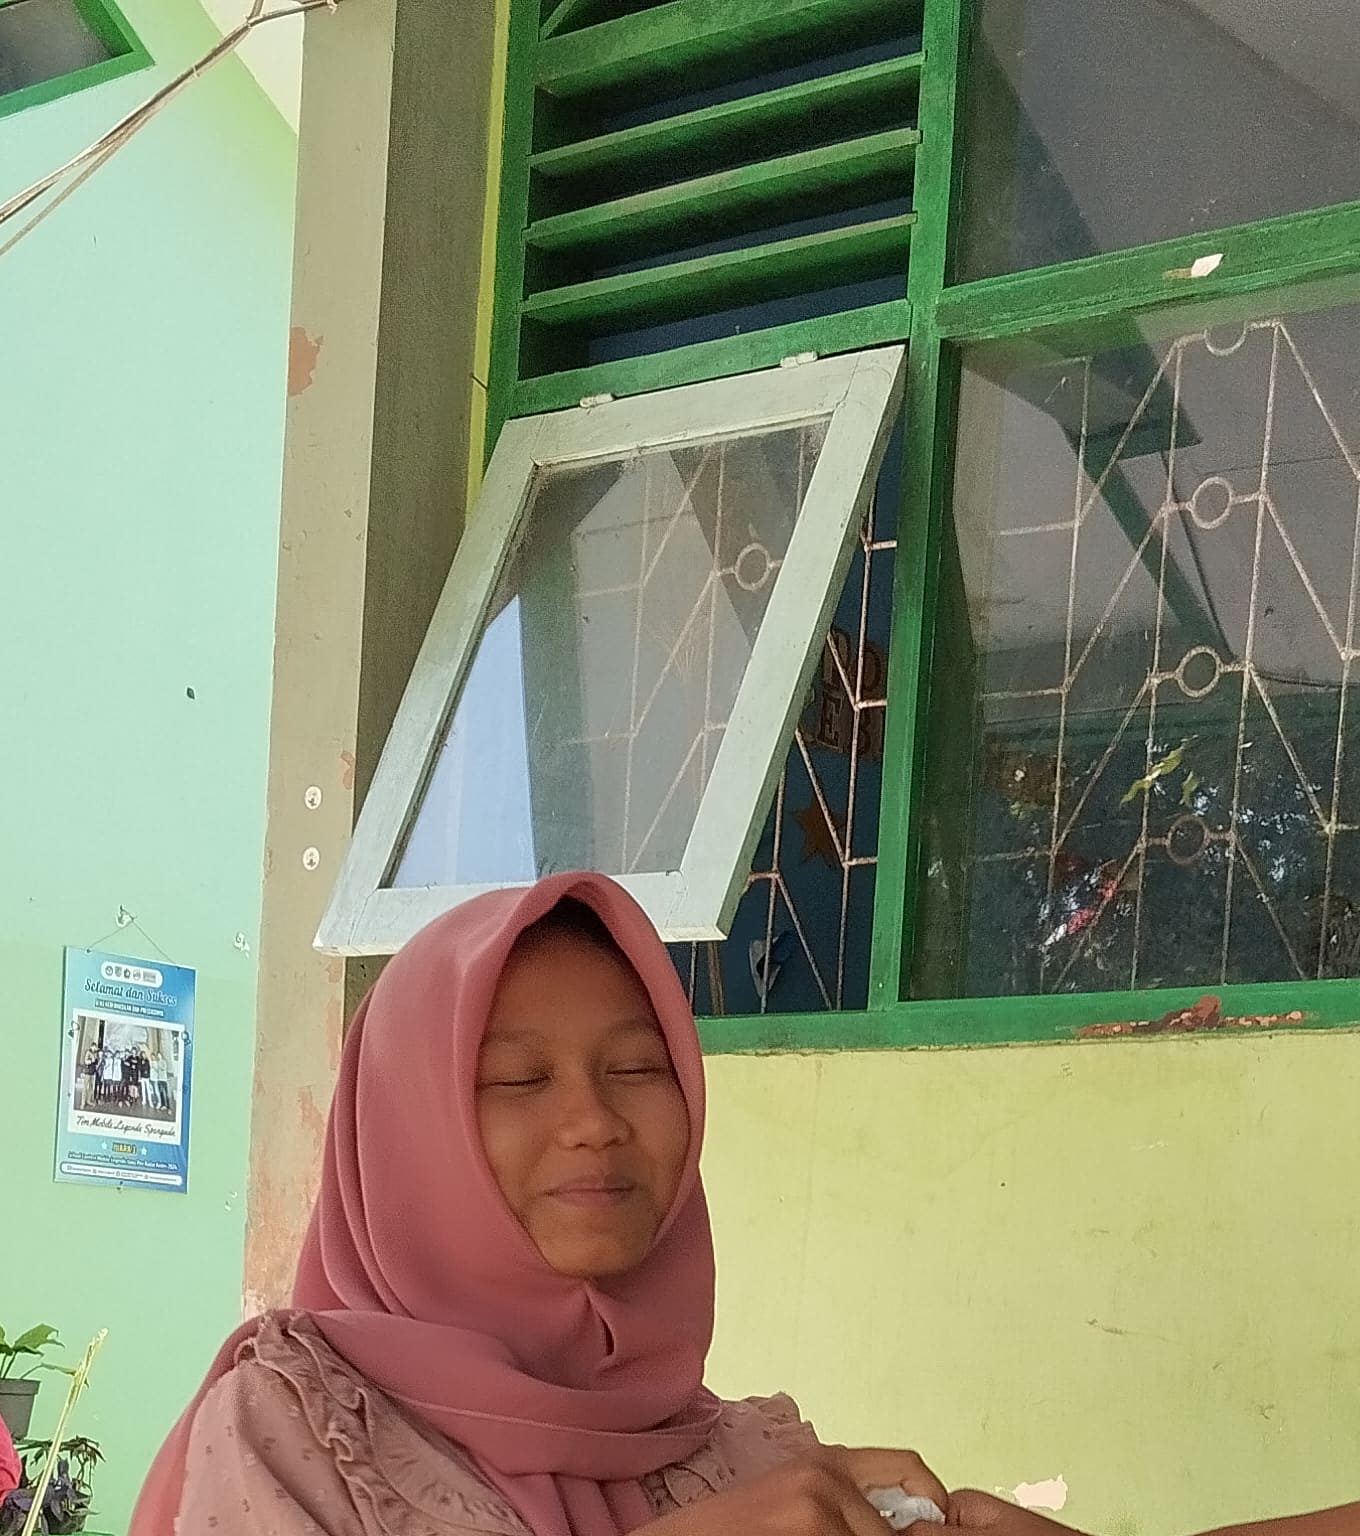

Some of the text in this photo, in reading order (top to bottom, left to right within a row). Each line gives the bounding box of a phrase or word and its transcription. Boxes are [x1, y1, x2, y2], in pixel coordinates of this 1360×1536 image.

[84, 978, 177, 1006] Selamat dan Sukses
